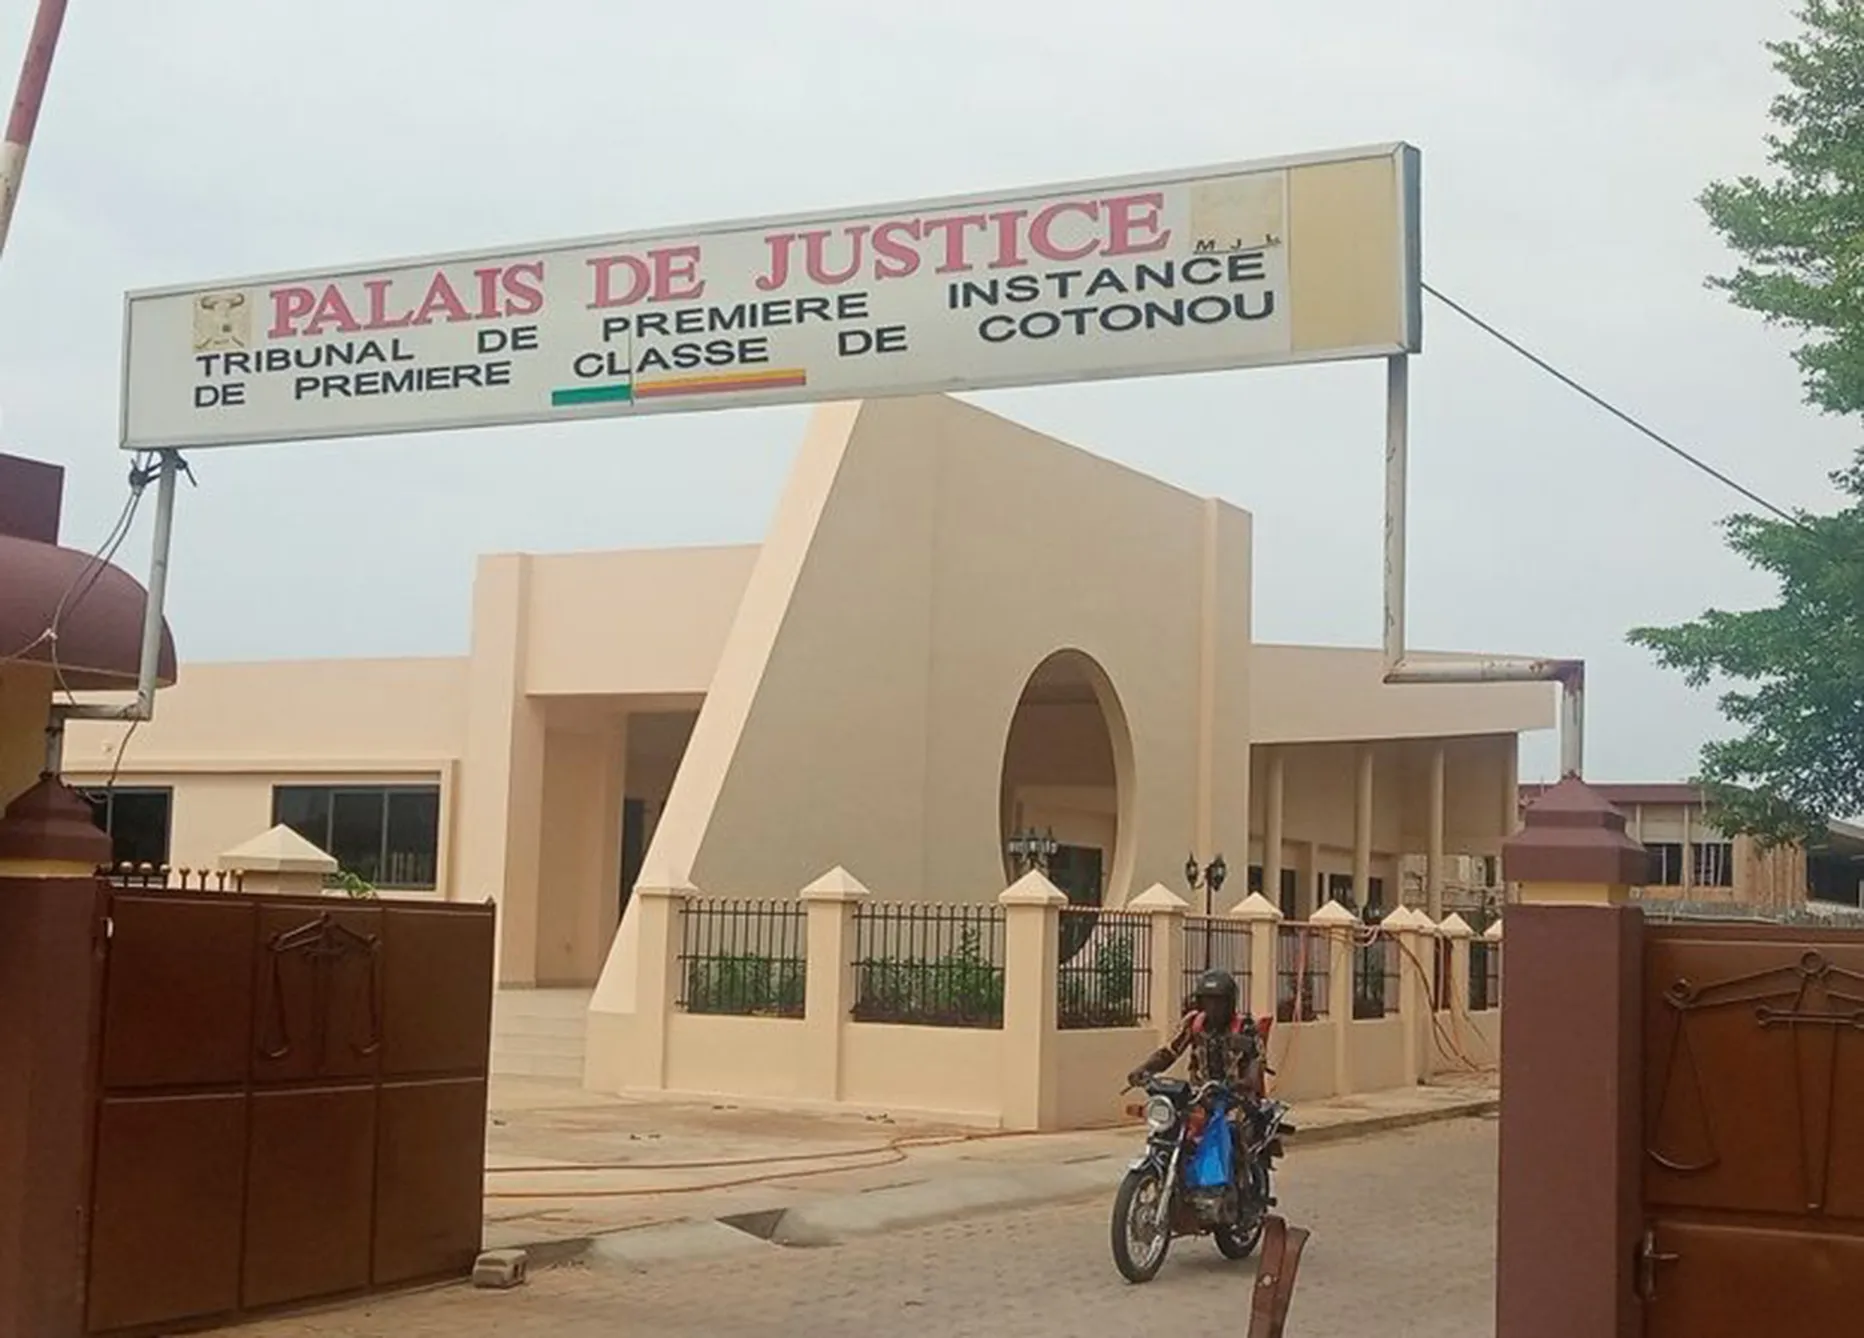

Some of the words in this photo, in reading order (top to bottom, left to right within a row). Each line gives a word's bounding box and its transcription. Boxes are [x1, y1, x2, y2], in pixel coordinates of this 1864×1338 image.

[268, 261, 545, 338] PALAIS
[586, 245, 706, 309] DE
[756, 194, 1170, 290] JUSTICE
[1196, 239, 1216, 251] M
[194, 383, 246, 408] DE
[294, 361, 512, 400] PREMIERE
[573, 337, 769, 378] CLASSE
[838, 325, 908, 357] DE
[978, 291, 1275, 343] COTONOU
[196, 338, 415, 378] TRIBUNAL
[477, 325, 539, 354] DE
[603, 292, 869, 342] PREMIERE
[948, 253, 1266, 309] INSTANCE
